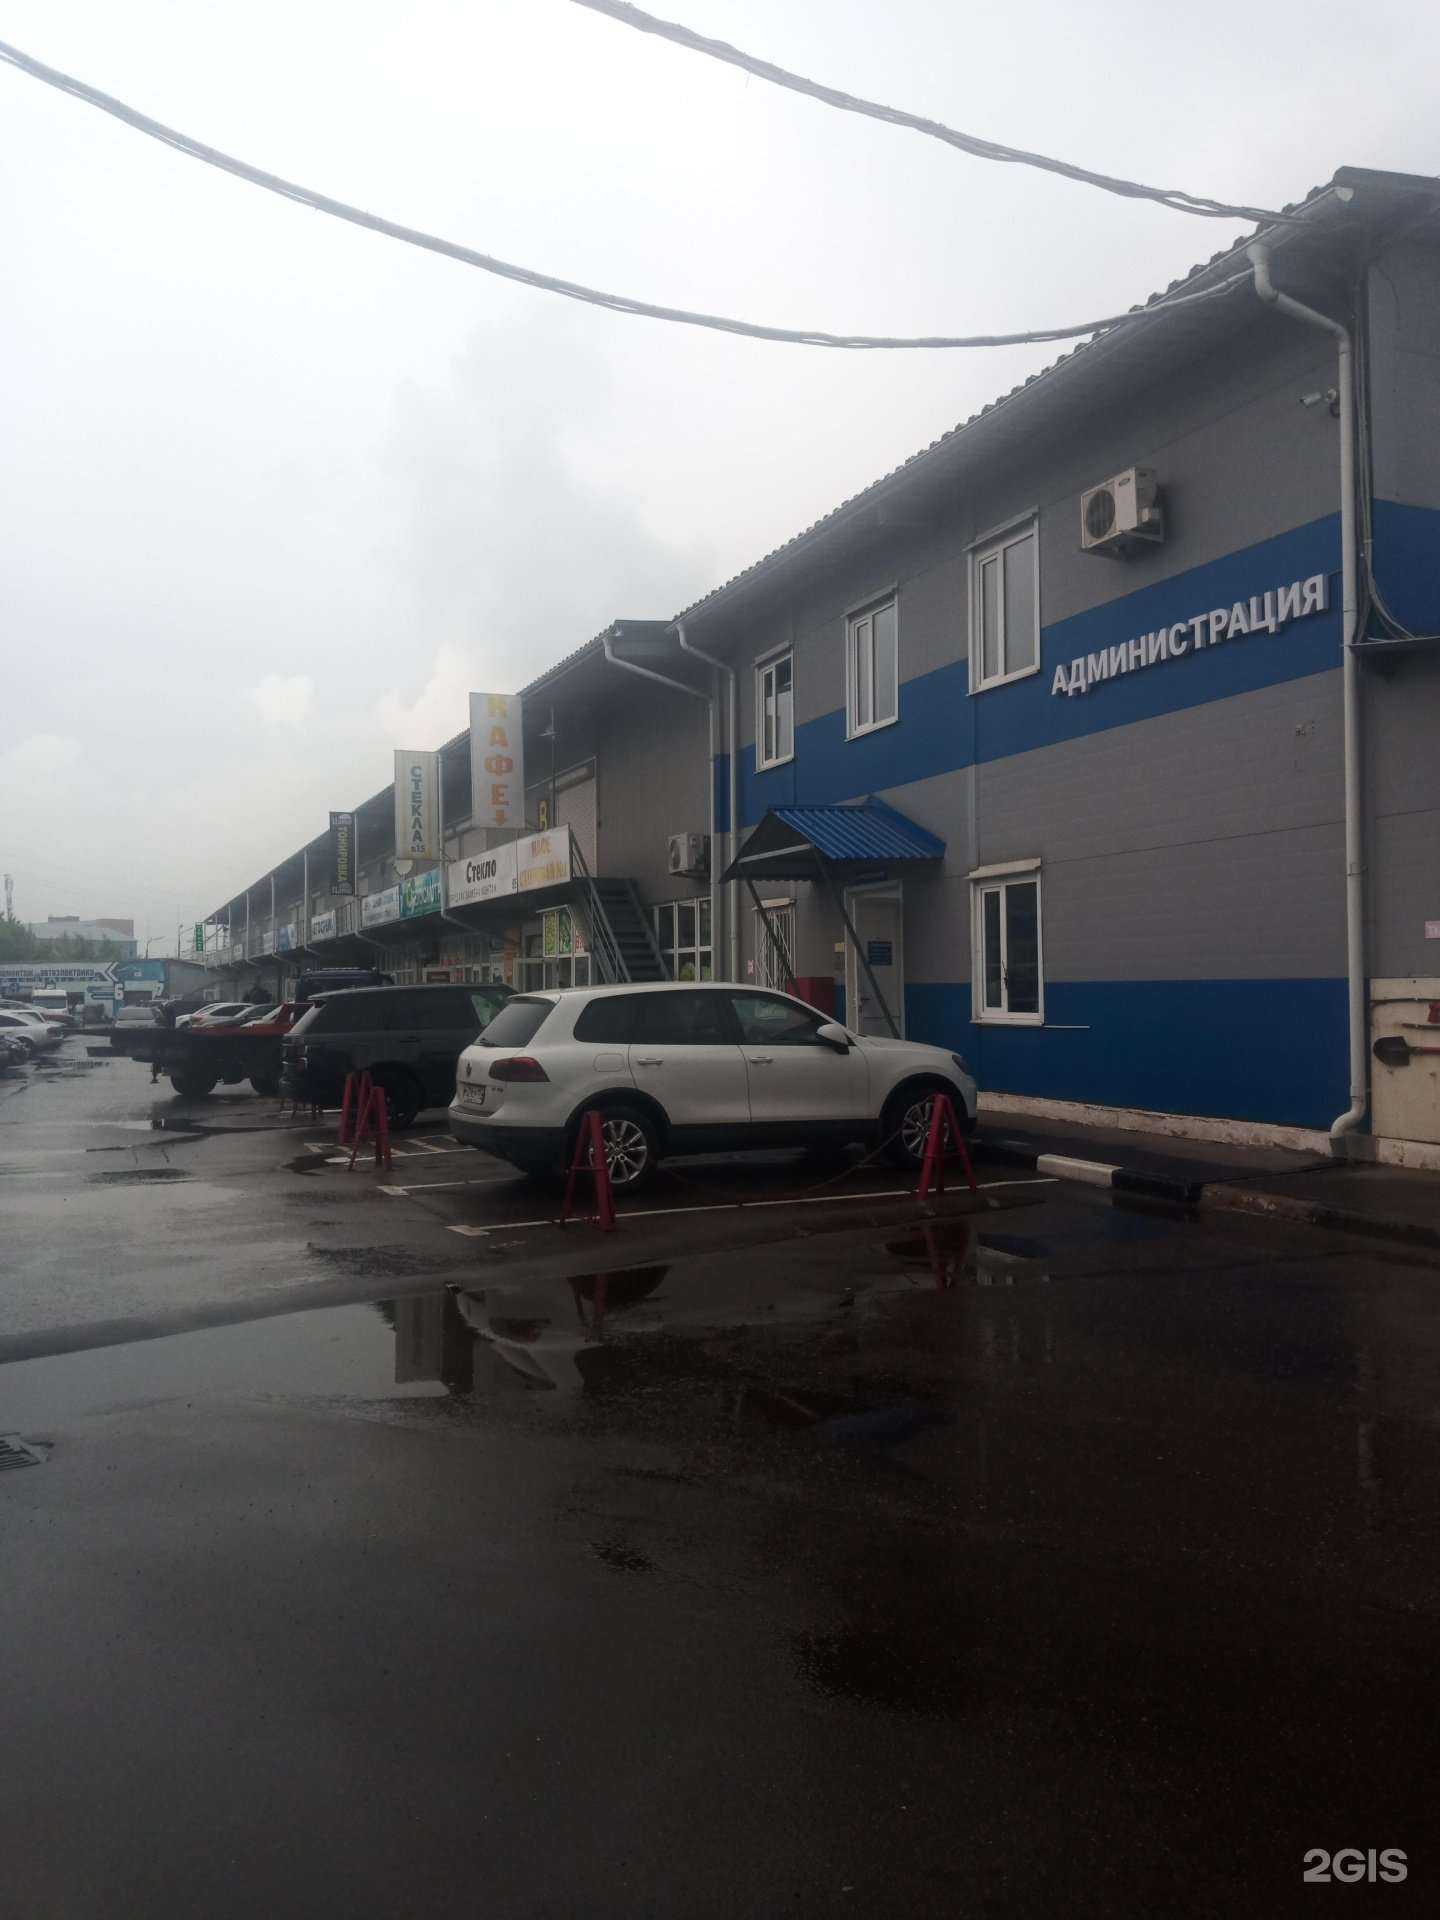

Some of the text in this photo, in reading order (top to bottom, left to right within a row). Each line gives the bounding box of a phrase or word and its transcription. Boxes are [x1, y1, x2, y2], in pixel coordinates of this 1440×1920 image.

[1051, 574, 1328, 696] АДМИНИСТРАЦИЯ
[484, 696, 513, 806] КАФЕ
[410, 766, 424, 842] СТЕКЛА
[466, 859, 497, 883] Стекло
